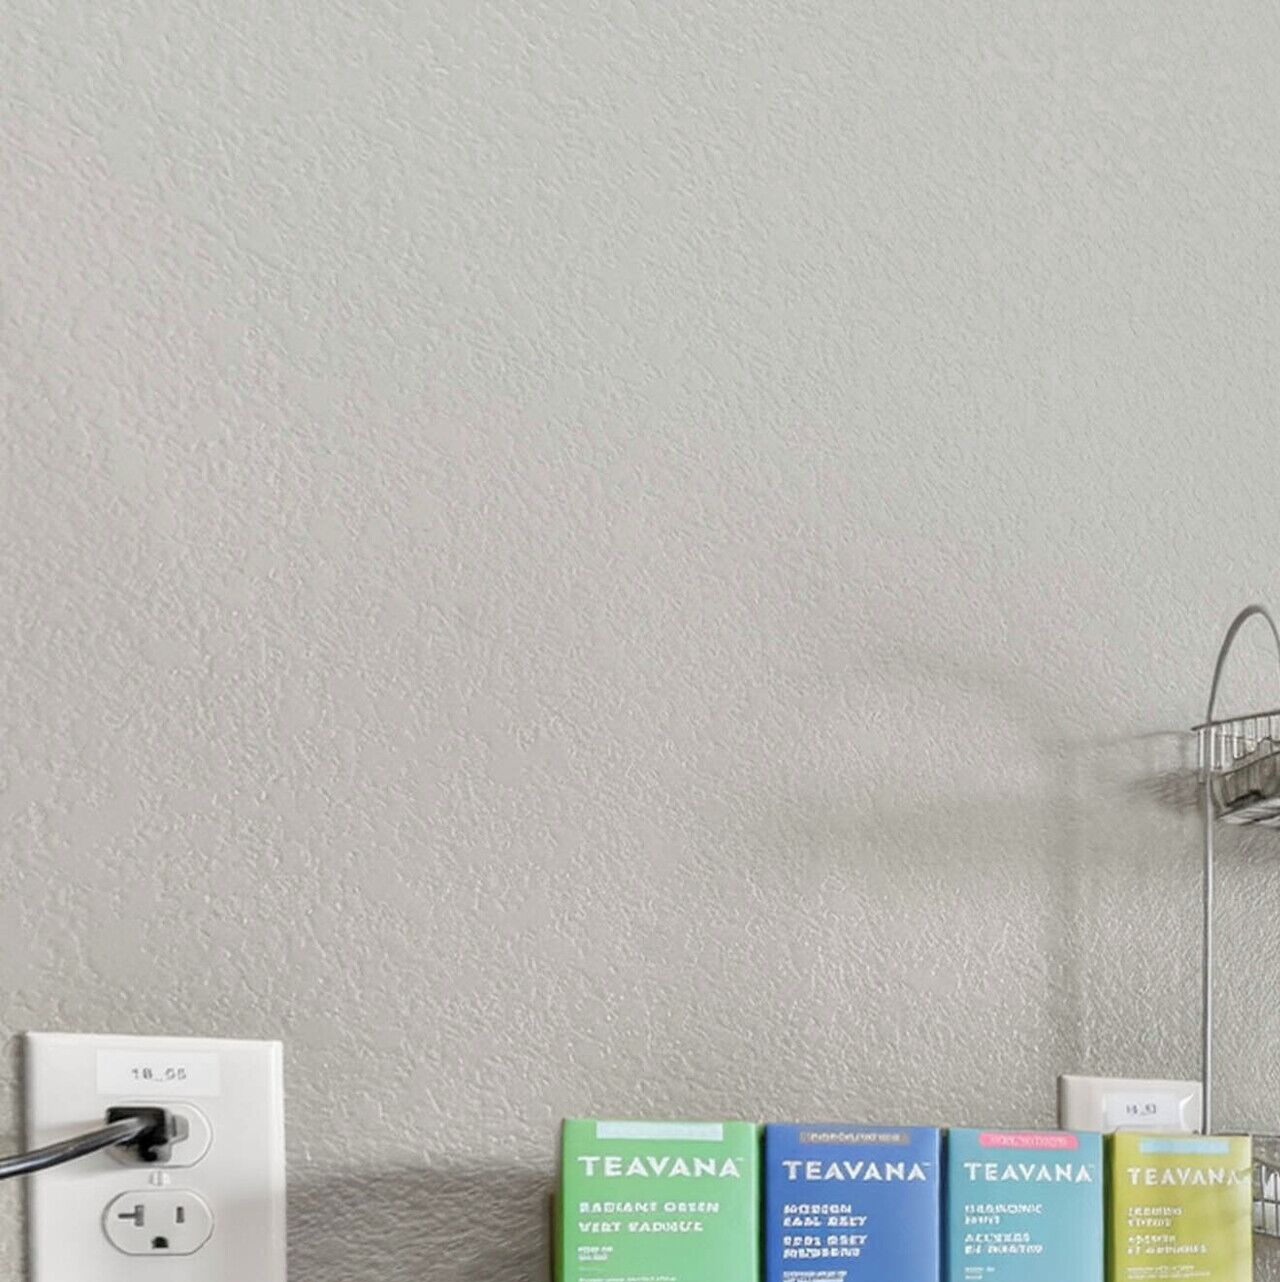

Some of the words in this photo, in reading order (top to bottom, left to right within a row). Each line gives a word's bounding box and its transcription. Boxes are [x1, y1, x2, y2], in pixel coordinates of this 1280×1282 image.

[577, 1155, 741, 1179] TEAVANA
[782, 1159, 928, 1182] TEAVANA
[963, 1161, 1093, 1183] TEAVANA
[1126, 1166, 1241, 1187] TEAVANA
